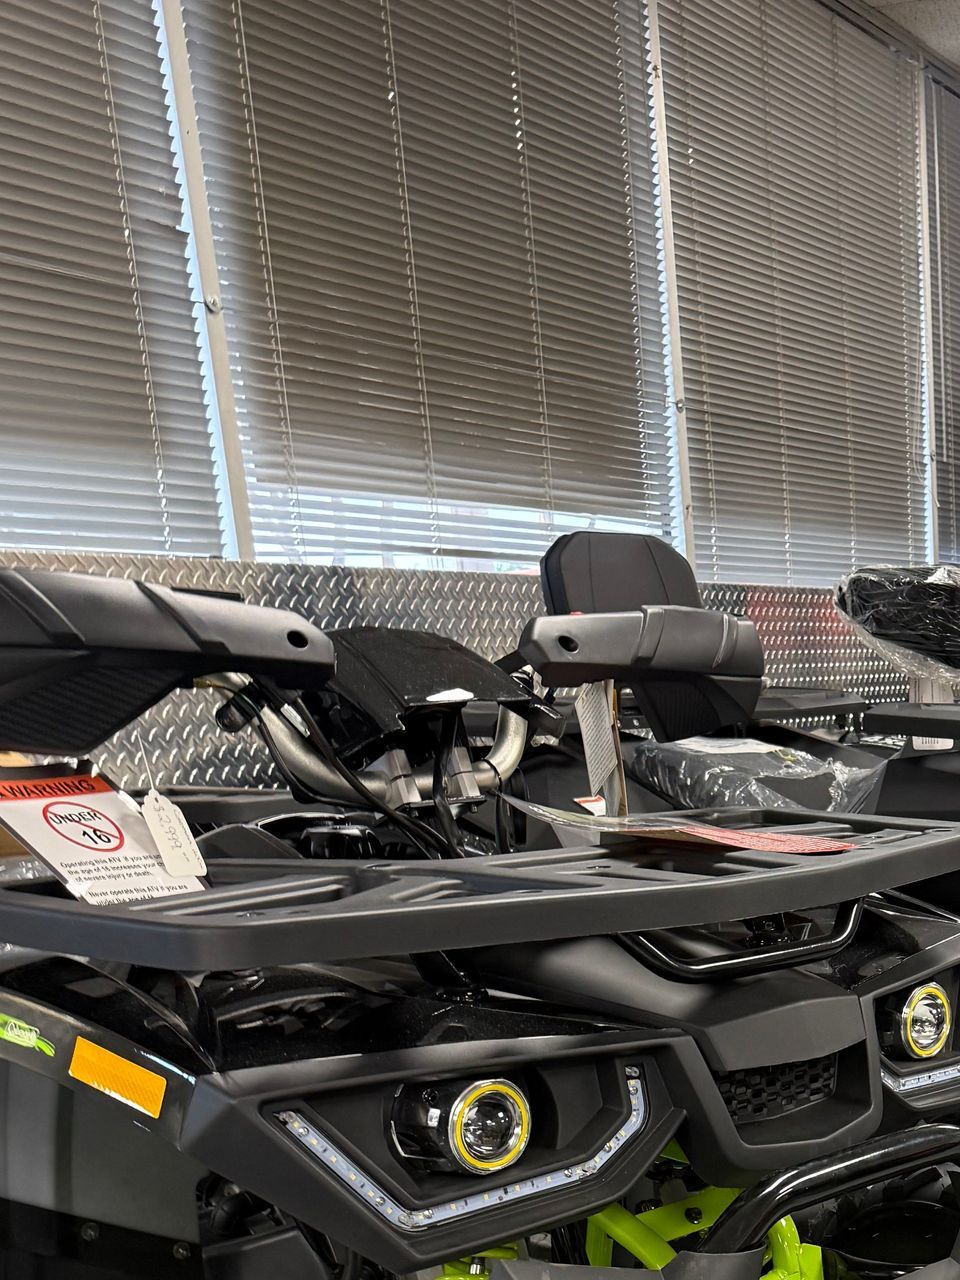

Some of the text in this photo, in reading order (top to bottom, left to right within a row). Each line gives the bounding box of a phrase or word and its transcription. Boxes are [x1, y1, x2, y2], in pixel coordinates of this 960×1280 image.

[2, 779, 96, 798] WARNING
[48, 811, 102, 825] UNDER
[82, 828, 112, 845] 16
